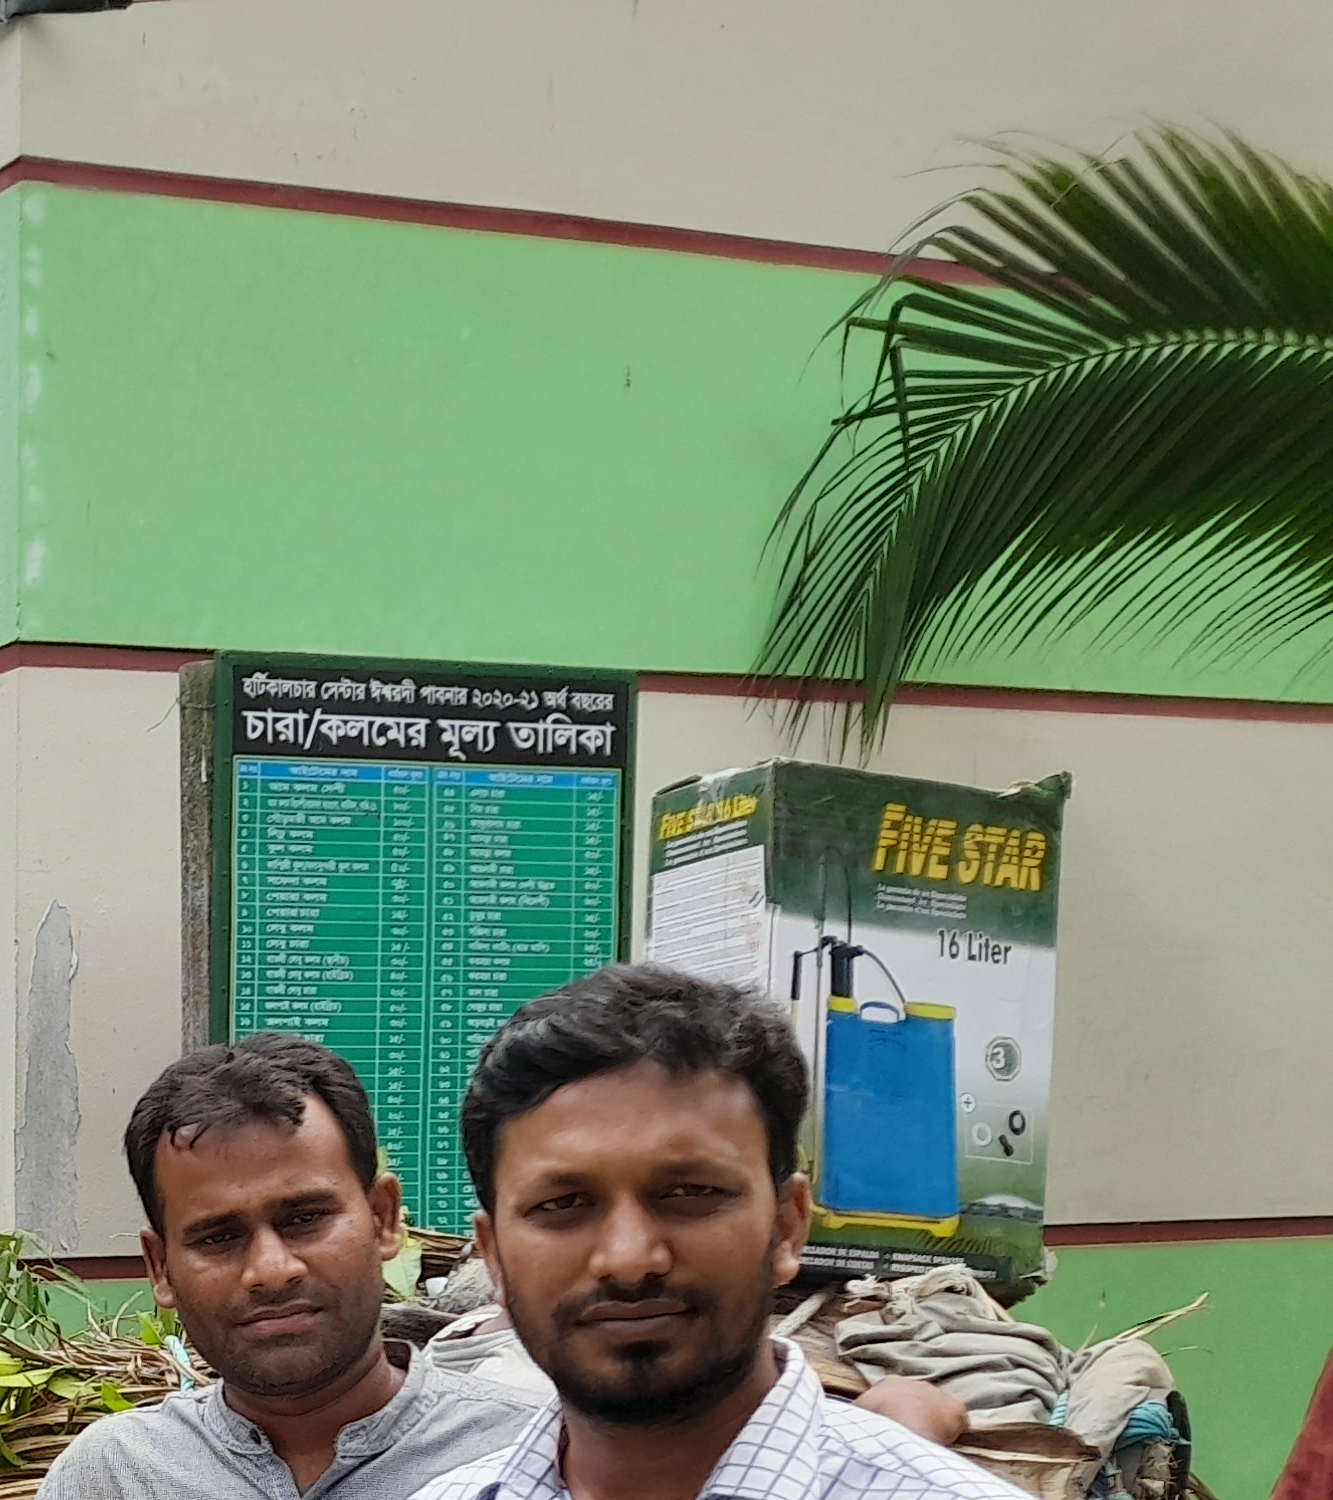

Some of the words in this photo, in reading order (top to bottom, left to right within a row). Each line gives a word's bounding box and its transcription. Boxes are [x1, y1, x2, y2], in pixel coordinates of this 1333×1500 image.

[471, 687, 539, 711] ২০২০-২১
[241, 708, 431, 750] চারা/কলমের
[437, 717, 501, 761] মূল্য
[506, 712, 616, 756] তালিকা
[873, 802, 958, 881] FIVE
[957, 823, 1047, 892] STAR
[937, 929, 959, 960] 16
[967, 932, 1012, 965] Liter
